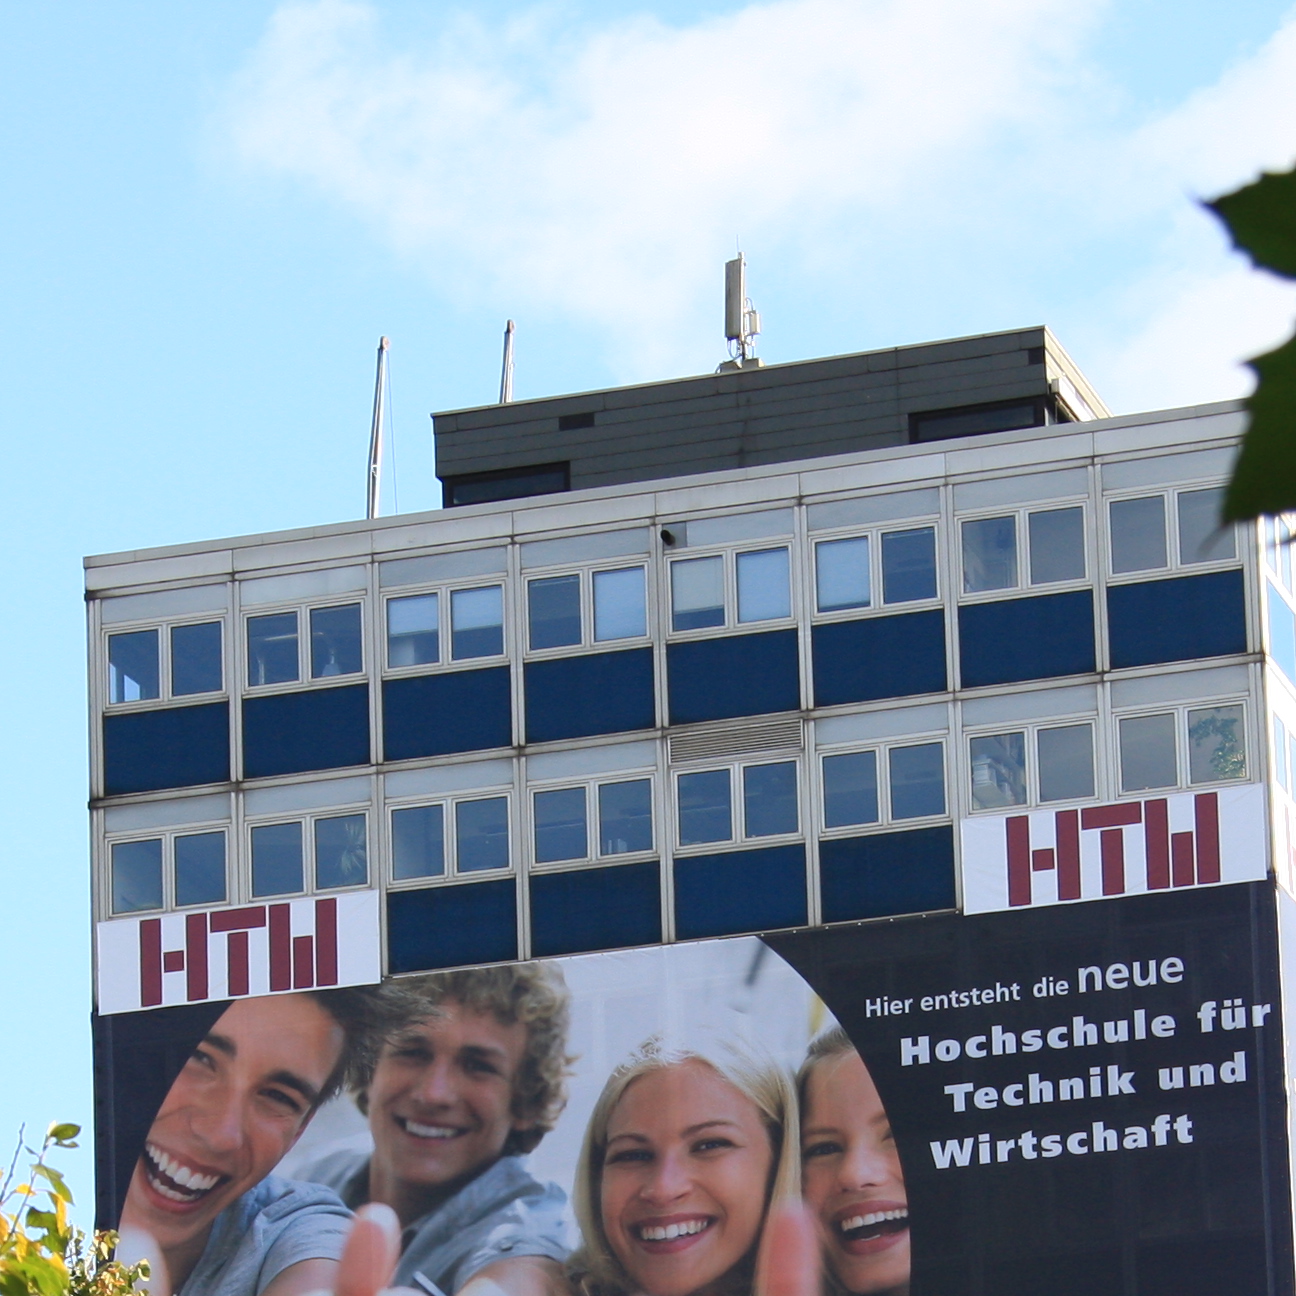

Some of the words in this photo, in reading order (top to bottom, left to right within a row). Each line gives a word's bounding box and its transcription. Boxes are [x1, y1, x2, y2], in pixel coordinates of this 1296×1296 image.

[1005, 791, 1221, 907] HTW
[139, 898, 338, 1007] HTW
[865, 996, 913, 1019] Hier
[920, 981, 1021, 1012] entsteht
[1032, 976, 1070, 1000] die
[1077, 956, 1184, 993] neue
[899, 1009, 1176, 1067] Hochschule
[1196, 998, 1272, 1035] für
[944, 1065, 1137, 1113] Technik
[1158, 1051, 1247, 1091] und
[929, 1113, 1194, 1170] Wirtschaft
